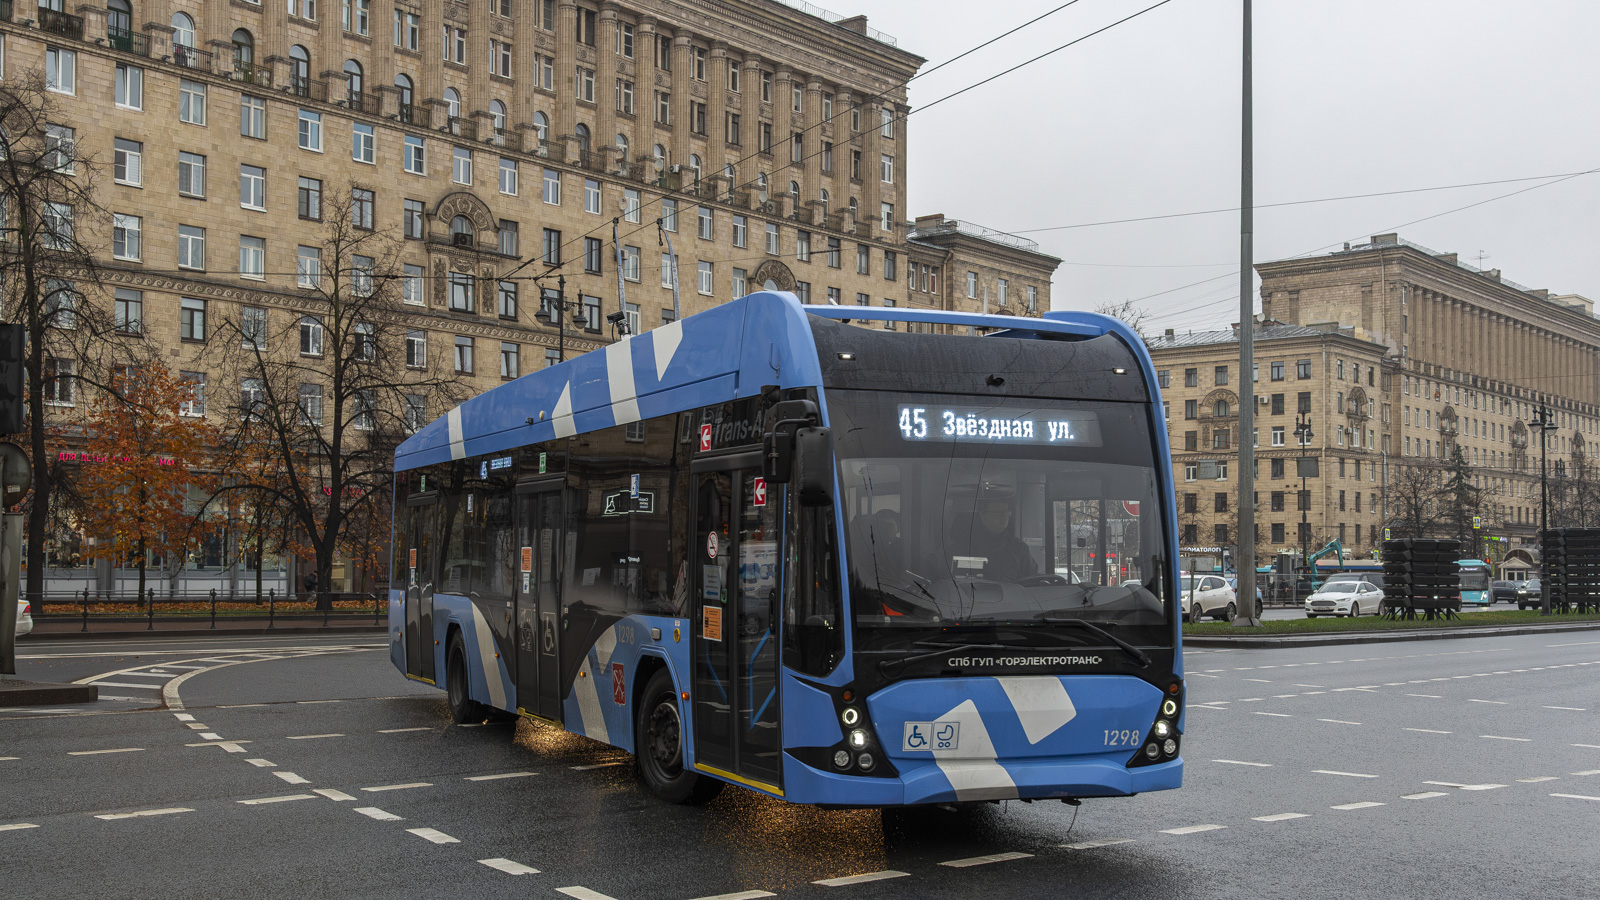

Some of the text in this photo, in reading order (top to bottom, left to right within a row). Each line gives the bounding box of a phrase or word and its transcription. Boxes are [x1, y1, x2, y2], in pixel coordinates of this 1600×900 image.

[900, 408, 1075, 441] 45 Звёздная ул.
[58, 452, 77, 462] ДЛЯ
[618, 624, 635, 645] 1298
[948, 656, 1102, 667] СПб ГУП «ГОРЭЛЕКТРОТРАНС»
[1104, 730, 1139, 746] 1298
